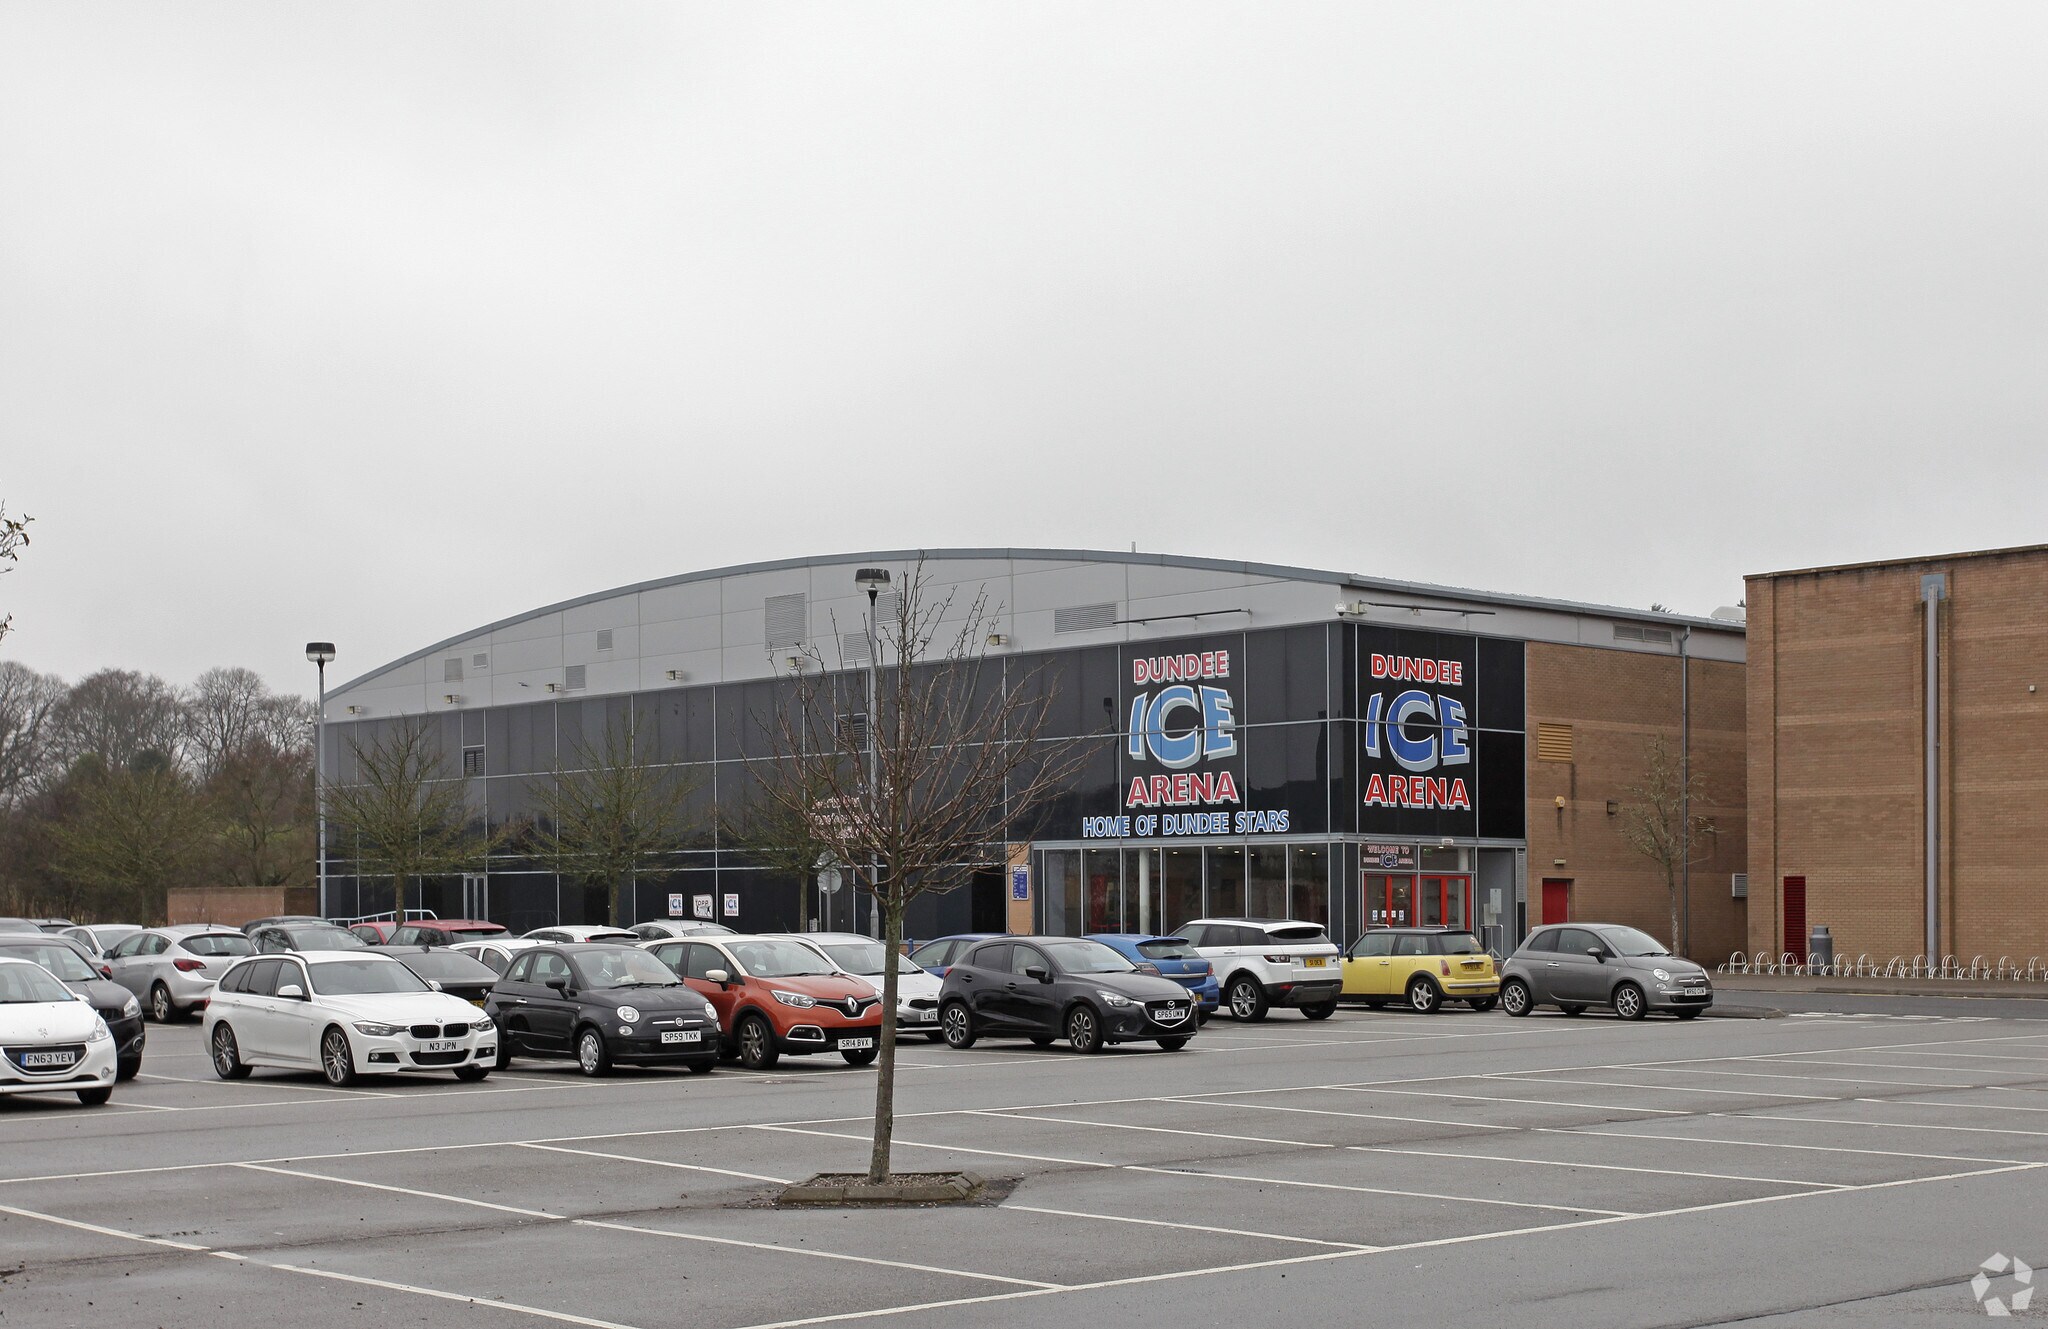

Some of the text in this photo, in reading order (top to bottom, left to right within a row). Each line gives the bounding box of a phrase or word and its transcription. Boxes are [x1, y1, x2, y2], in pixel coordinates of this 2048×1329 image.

[1133, 650, 1230, 685] DUNDEE
[1370, 653, 1462, 686] DUNDEE
[1129, 684, 1237, 770] ICE
[1365, 689, 1470, 772] ICE
[1126, 771, 1240, 808] ARENA
[1364, 773, 1471, 811] ARENA
[1082, 810, 1290, 837] HOME OF DUNDEE STARS
[1367, 845, 1410, 855] WELCOME TO
[1380, 853, 1398, 868] ICE
[429, 1041, 457, 1051] N3 JPN
[664, 1032, 698, 1041] SP59 TKK
[841, 1040, 856, 1048] SR14
[27, 1053, 73, 1064] FN63 YEV
